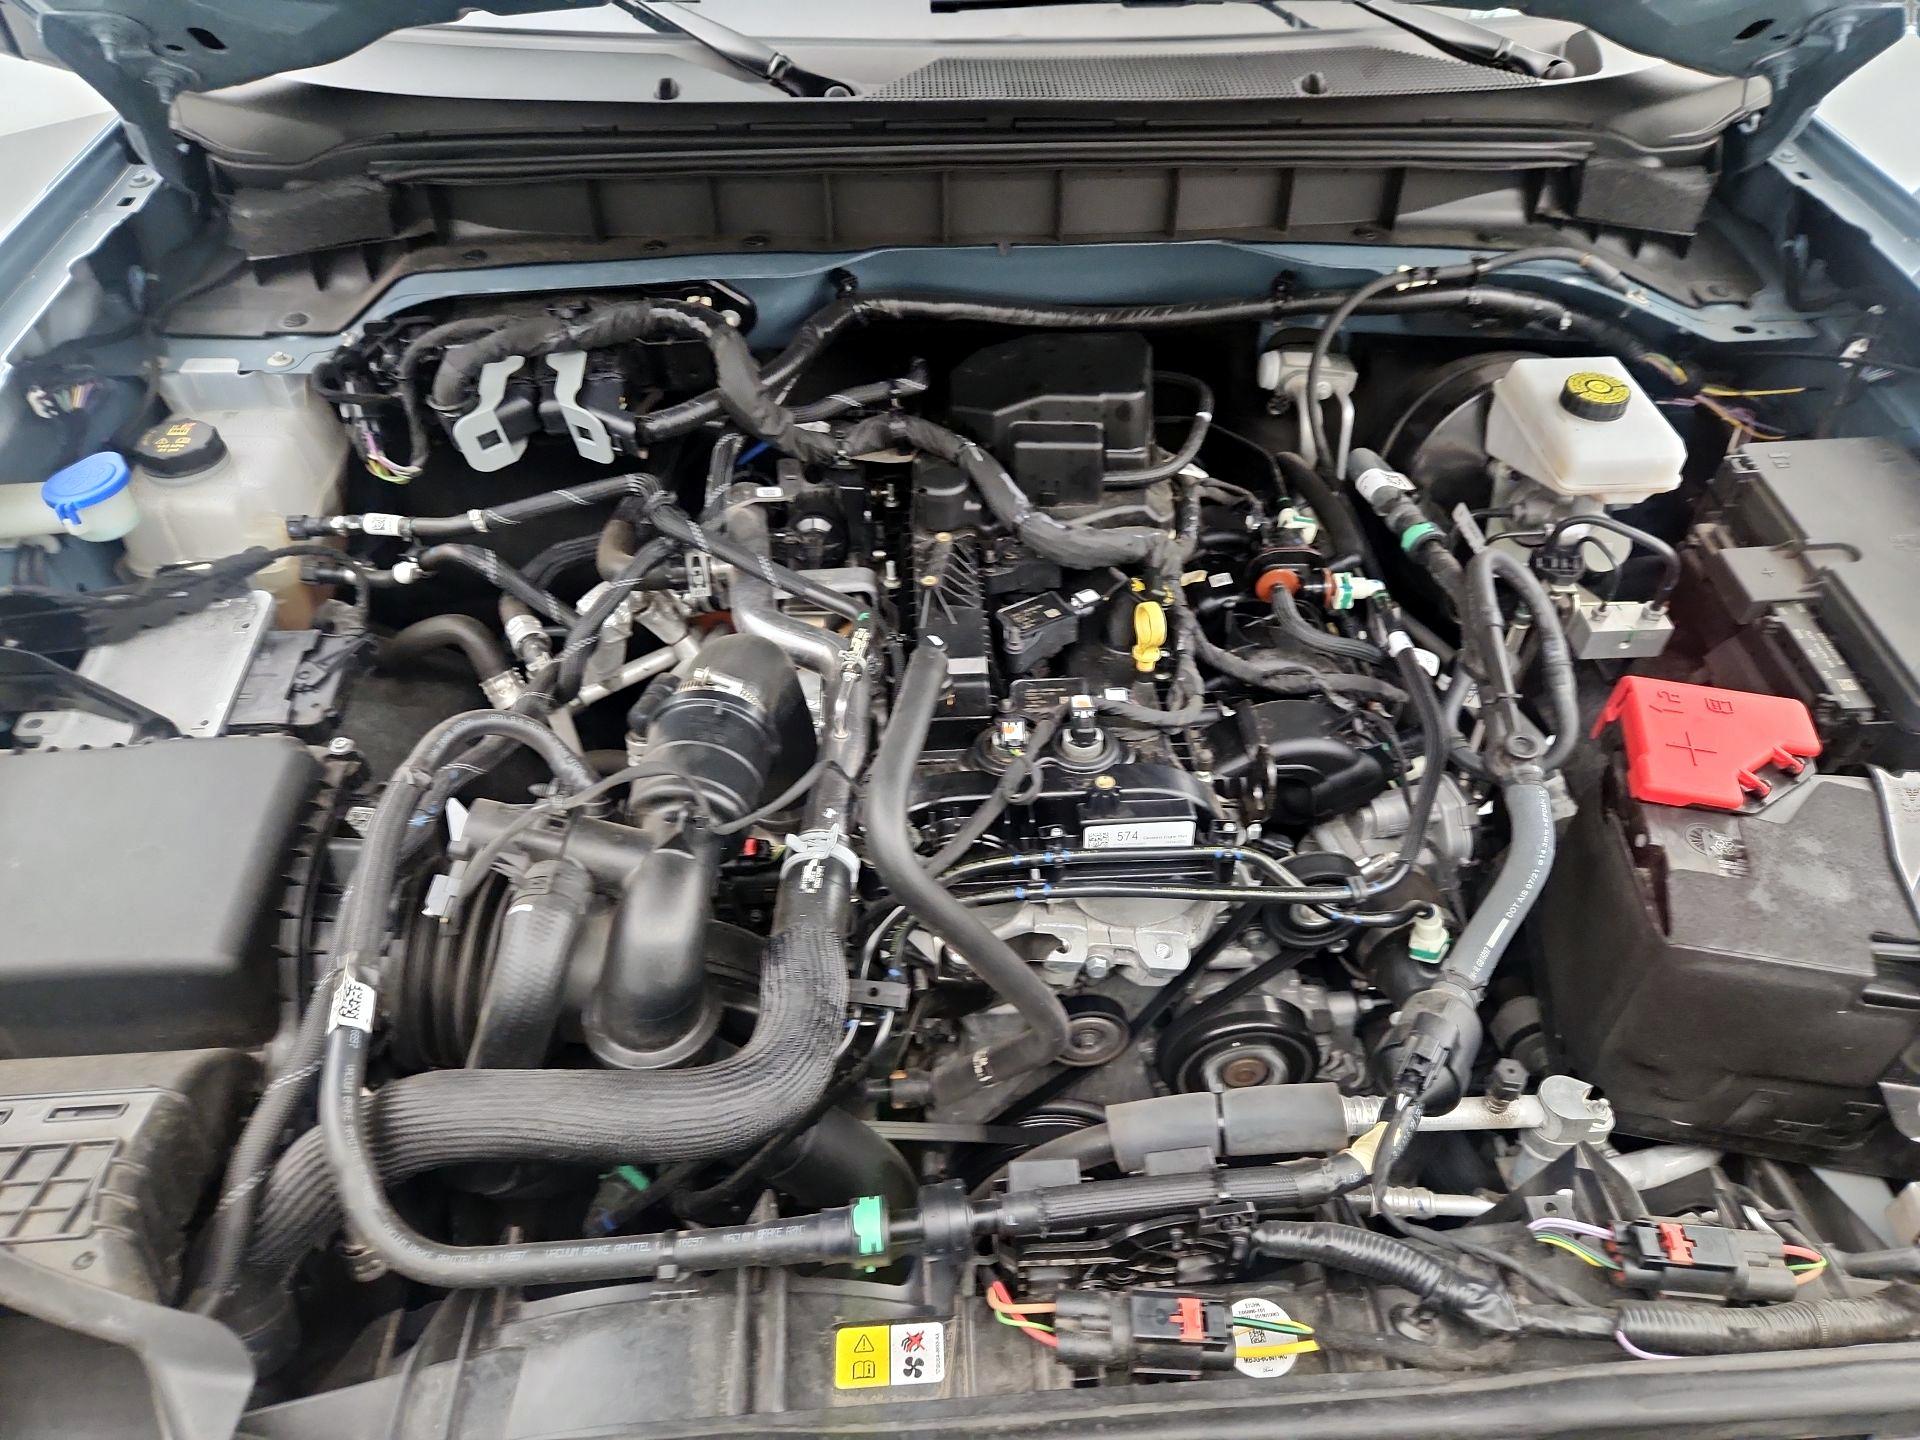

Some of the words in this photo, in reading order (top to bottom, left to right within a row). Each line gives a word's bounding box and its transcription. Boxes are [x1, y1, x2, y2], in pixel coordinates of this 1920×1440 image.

[1117, 831, 1138, 841] 574
[1506, 902, 1520, 918] DOT
[1517, 889, 1529, 903] AIS
[1526, 868, 1540, 890] 07/21
